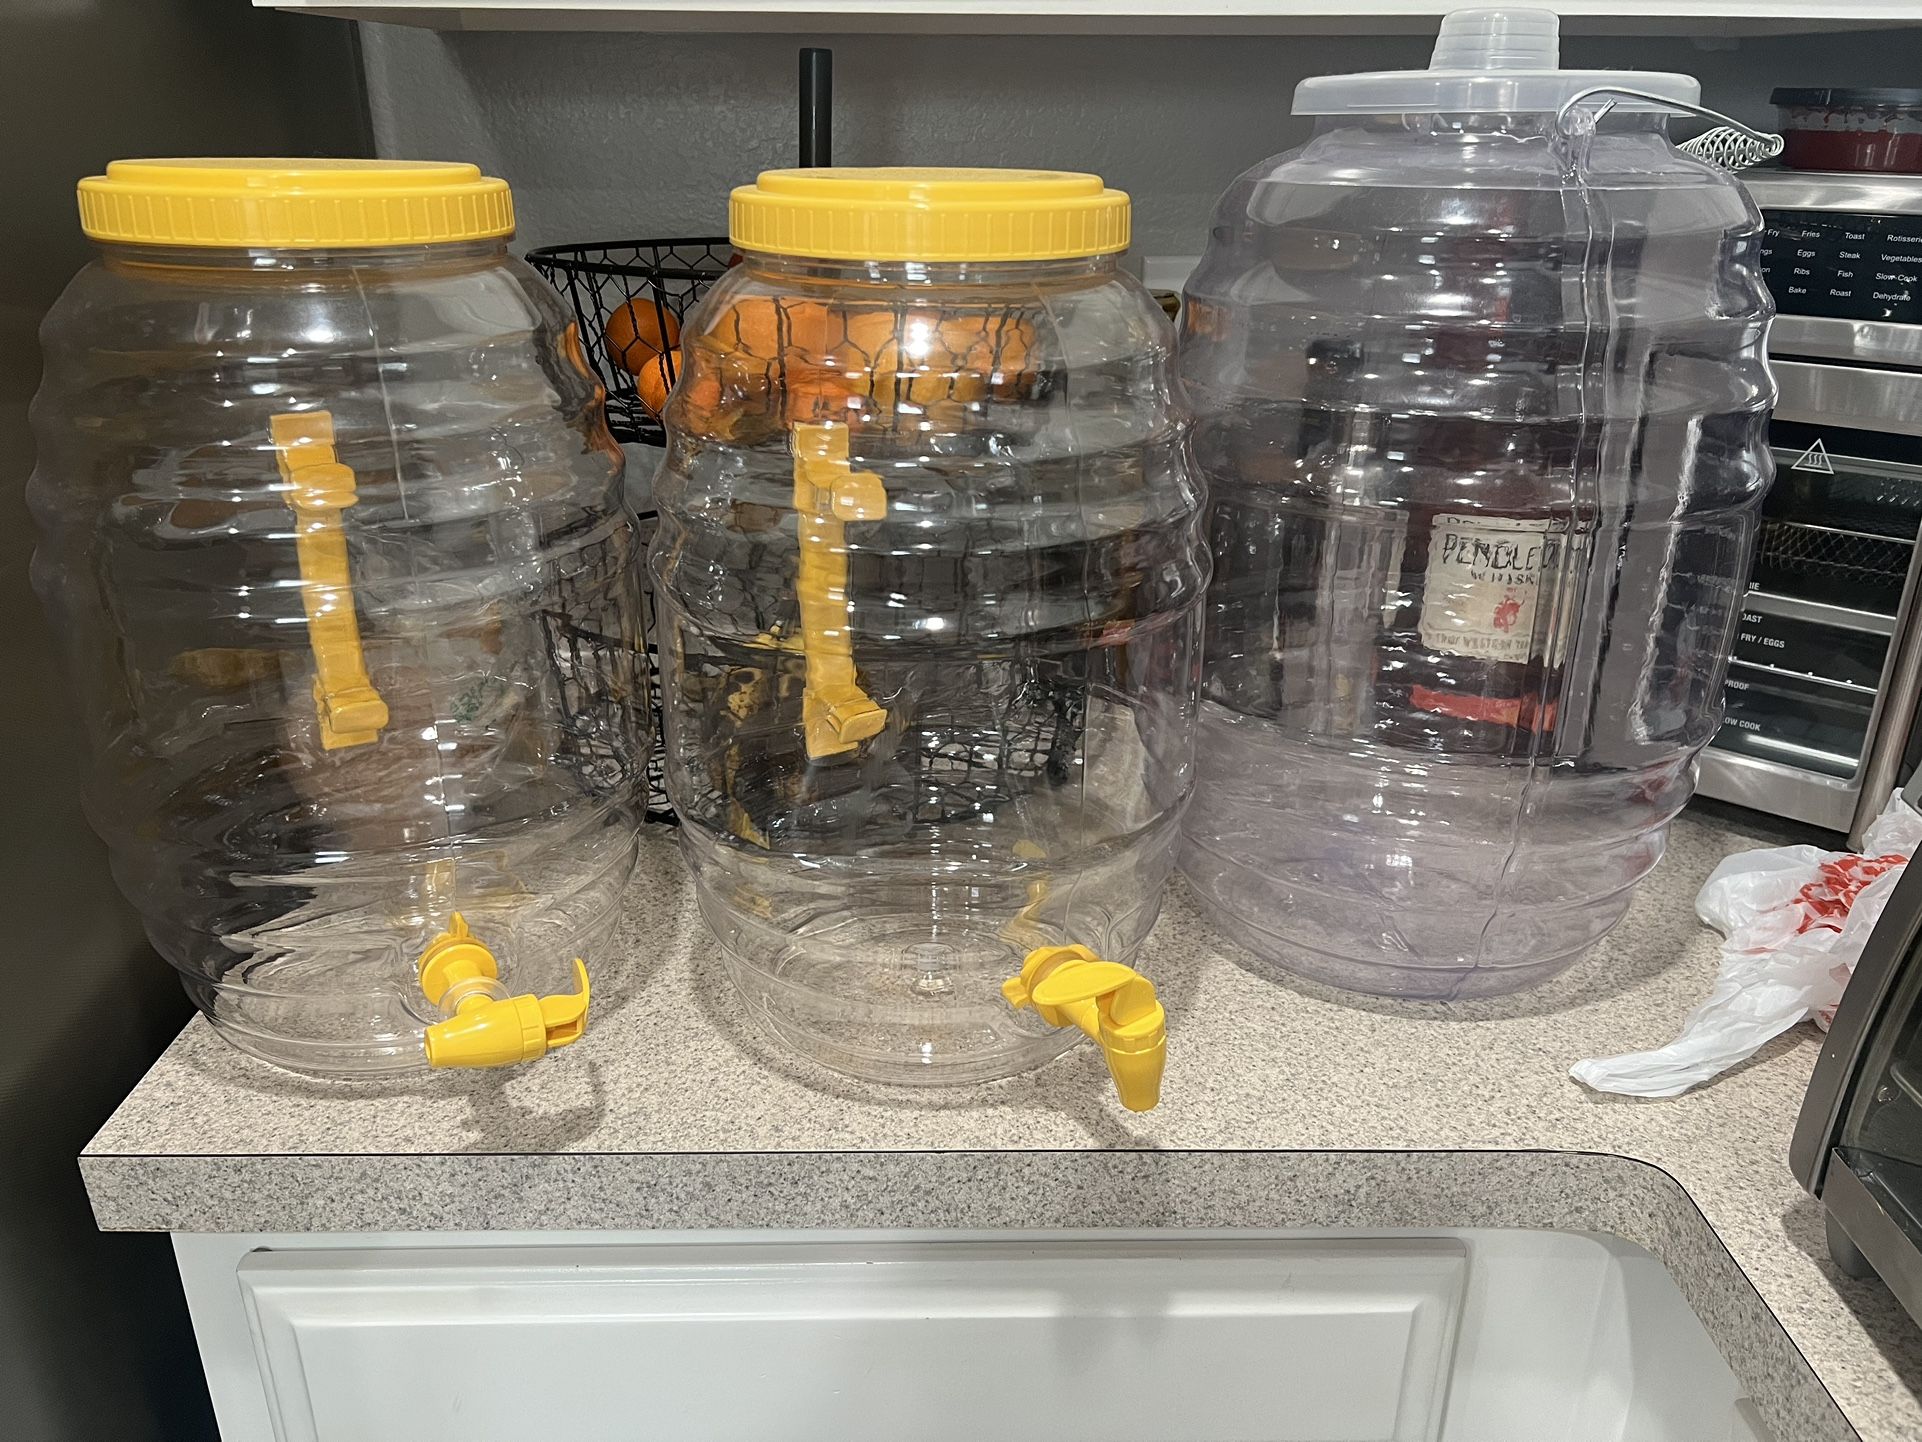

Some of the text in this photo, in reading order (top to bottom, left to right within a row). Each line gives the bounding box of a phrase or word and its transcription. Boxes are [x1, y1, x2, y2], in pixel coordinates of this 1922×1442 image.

[1767, 229, 1780, 237] Fry
[1801, 230, 1820, 238] Fries
[1845, 232, 1865, 240] Toast
[1797, 249, 1816, 258] Eggs
[1839, 251, 1861, 259] Steak
[1881, 253, 1922, 263] Vegetables
[1793, 267, 1810, 275] Ribs
[1837, 270, 1854, 278] Fish
[1897, 274, 1918, 282] Cook
[1788, 286, 1807, 294] Bake
[1829, 289, 1852, 297] Roast
[1872, 291, 1911, 302] Dehydrate
[1740, 633, 1756, 643] FRY
[1763, 637, 1785, 648] EGGS
[1739, 720, 1761, 731] COOK
